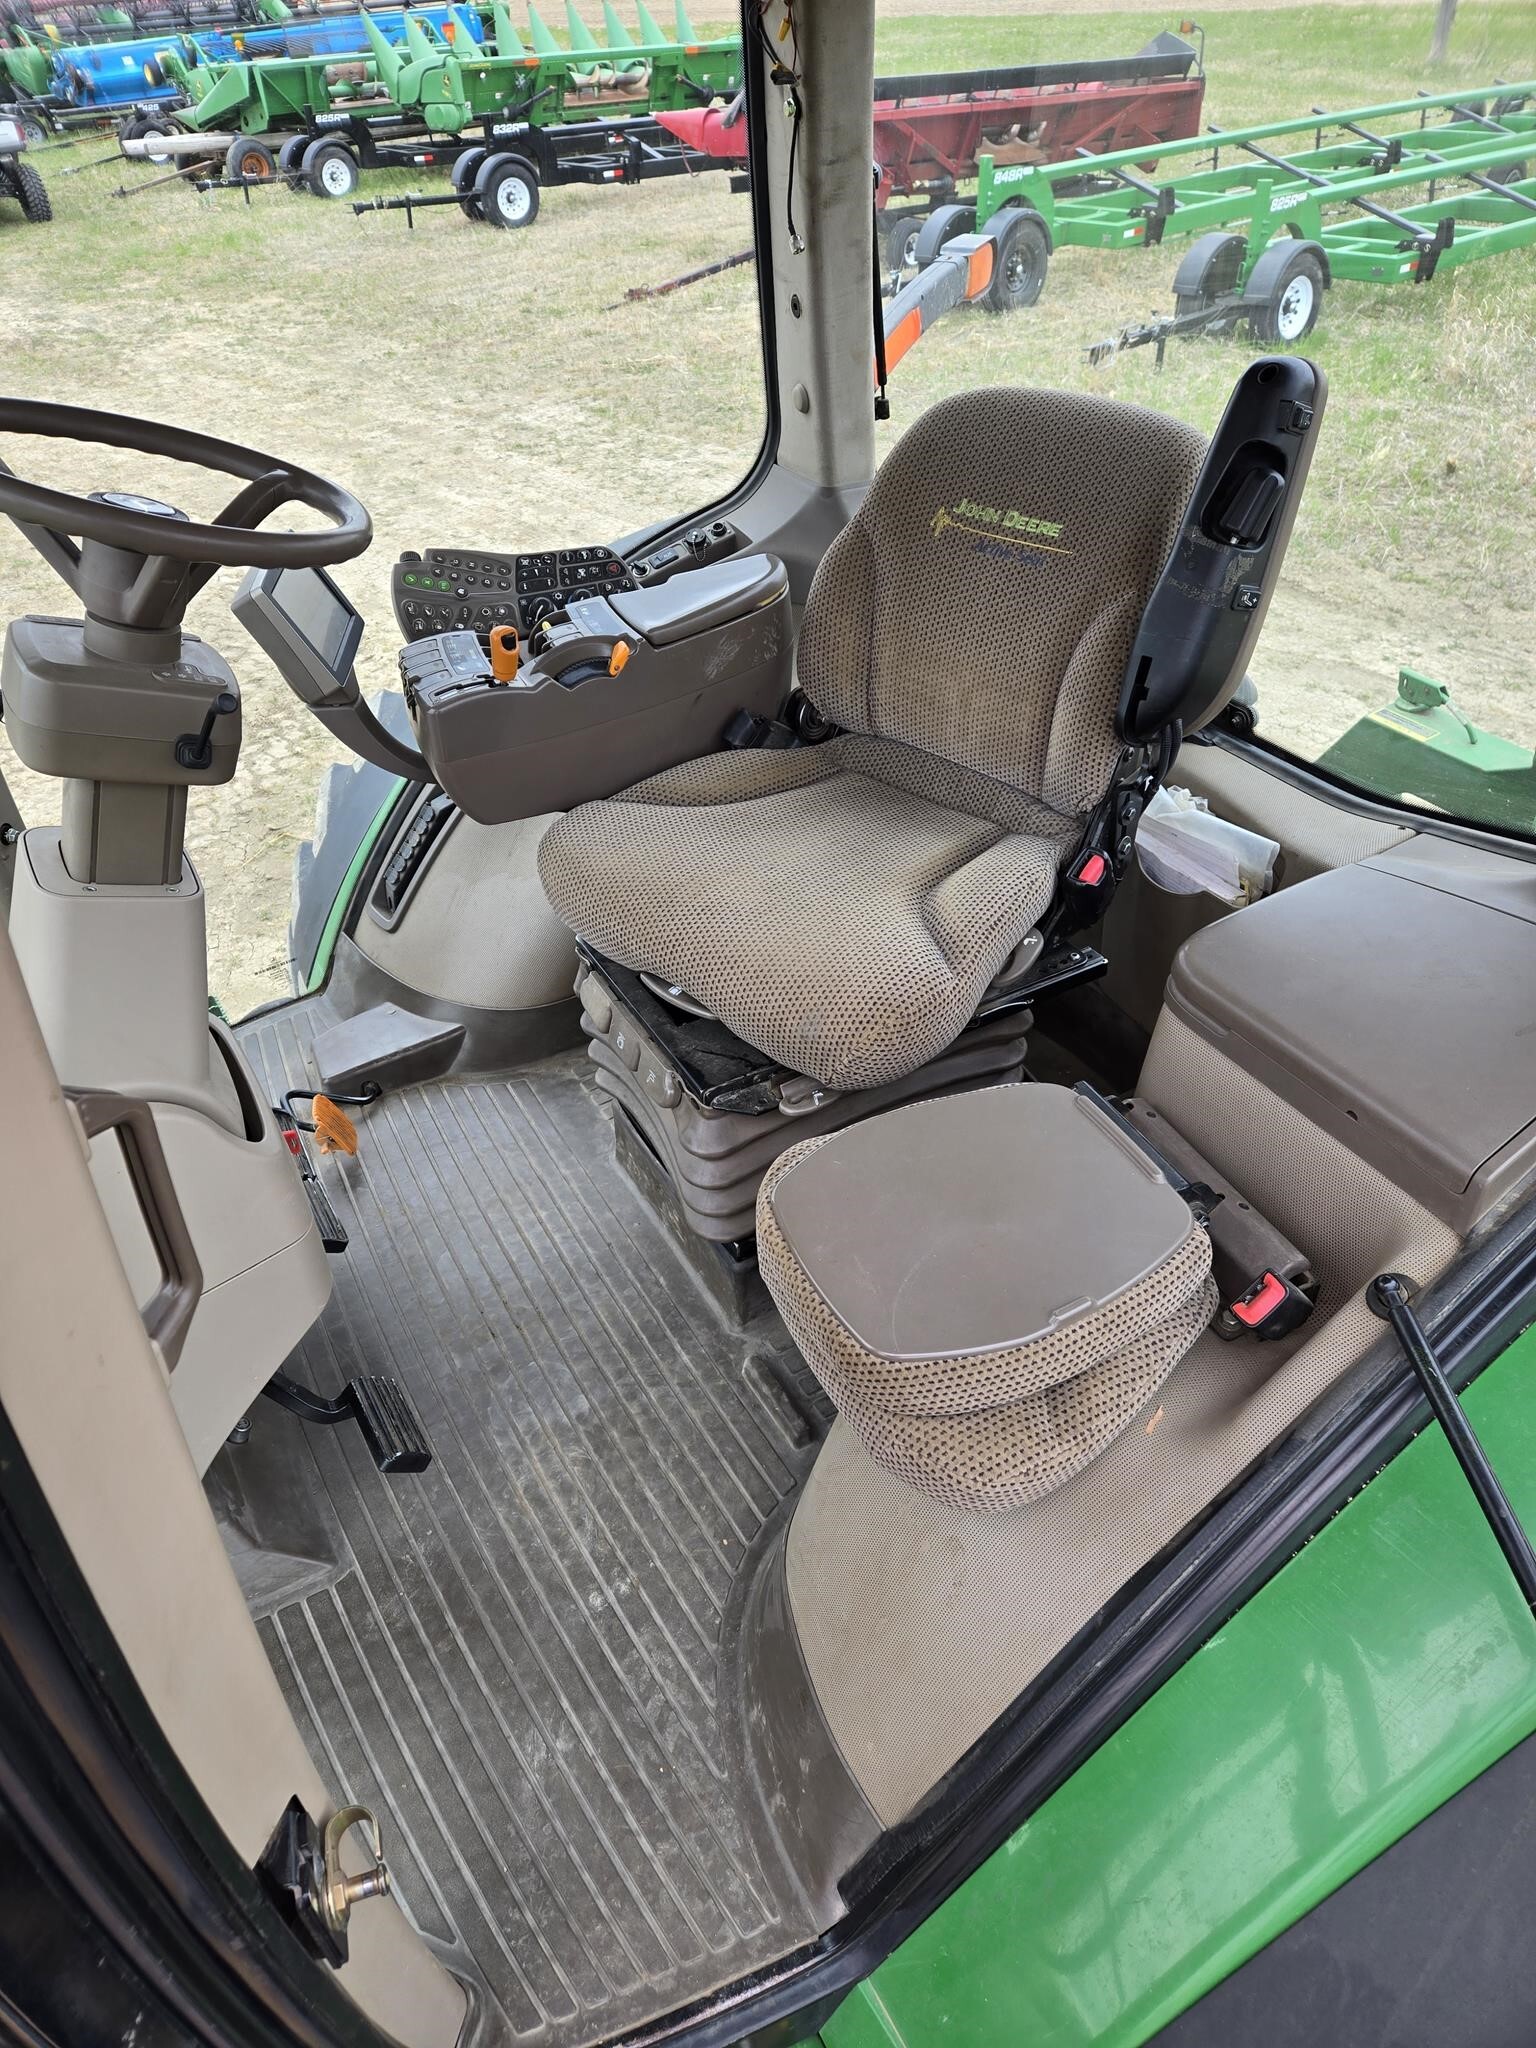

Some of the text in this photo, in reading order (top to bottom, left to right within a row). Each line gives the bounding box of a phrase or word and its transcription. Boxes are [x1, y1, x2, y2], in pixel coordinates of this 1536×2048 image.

[493, 123, 520, 135] 832R
[953, 498, 1064, 537] JOHN DEERE
